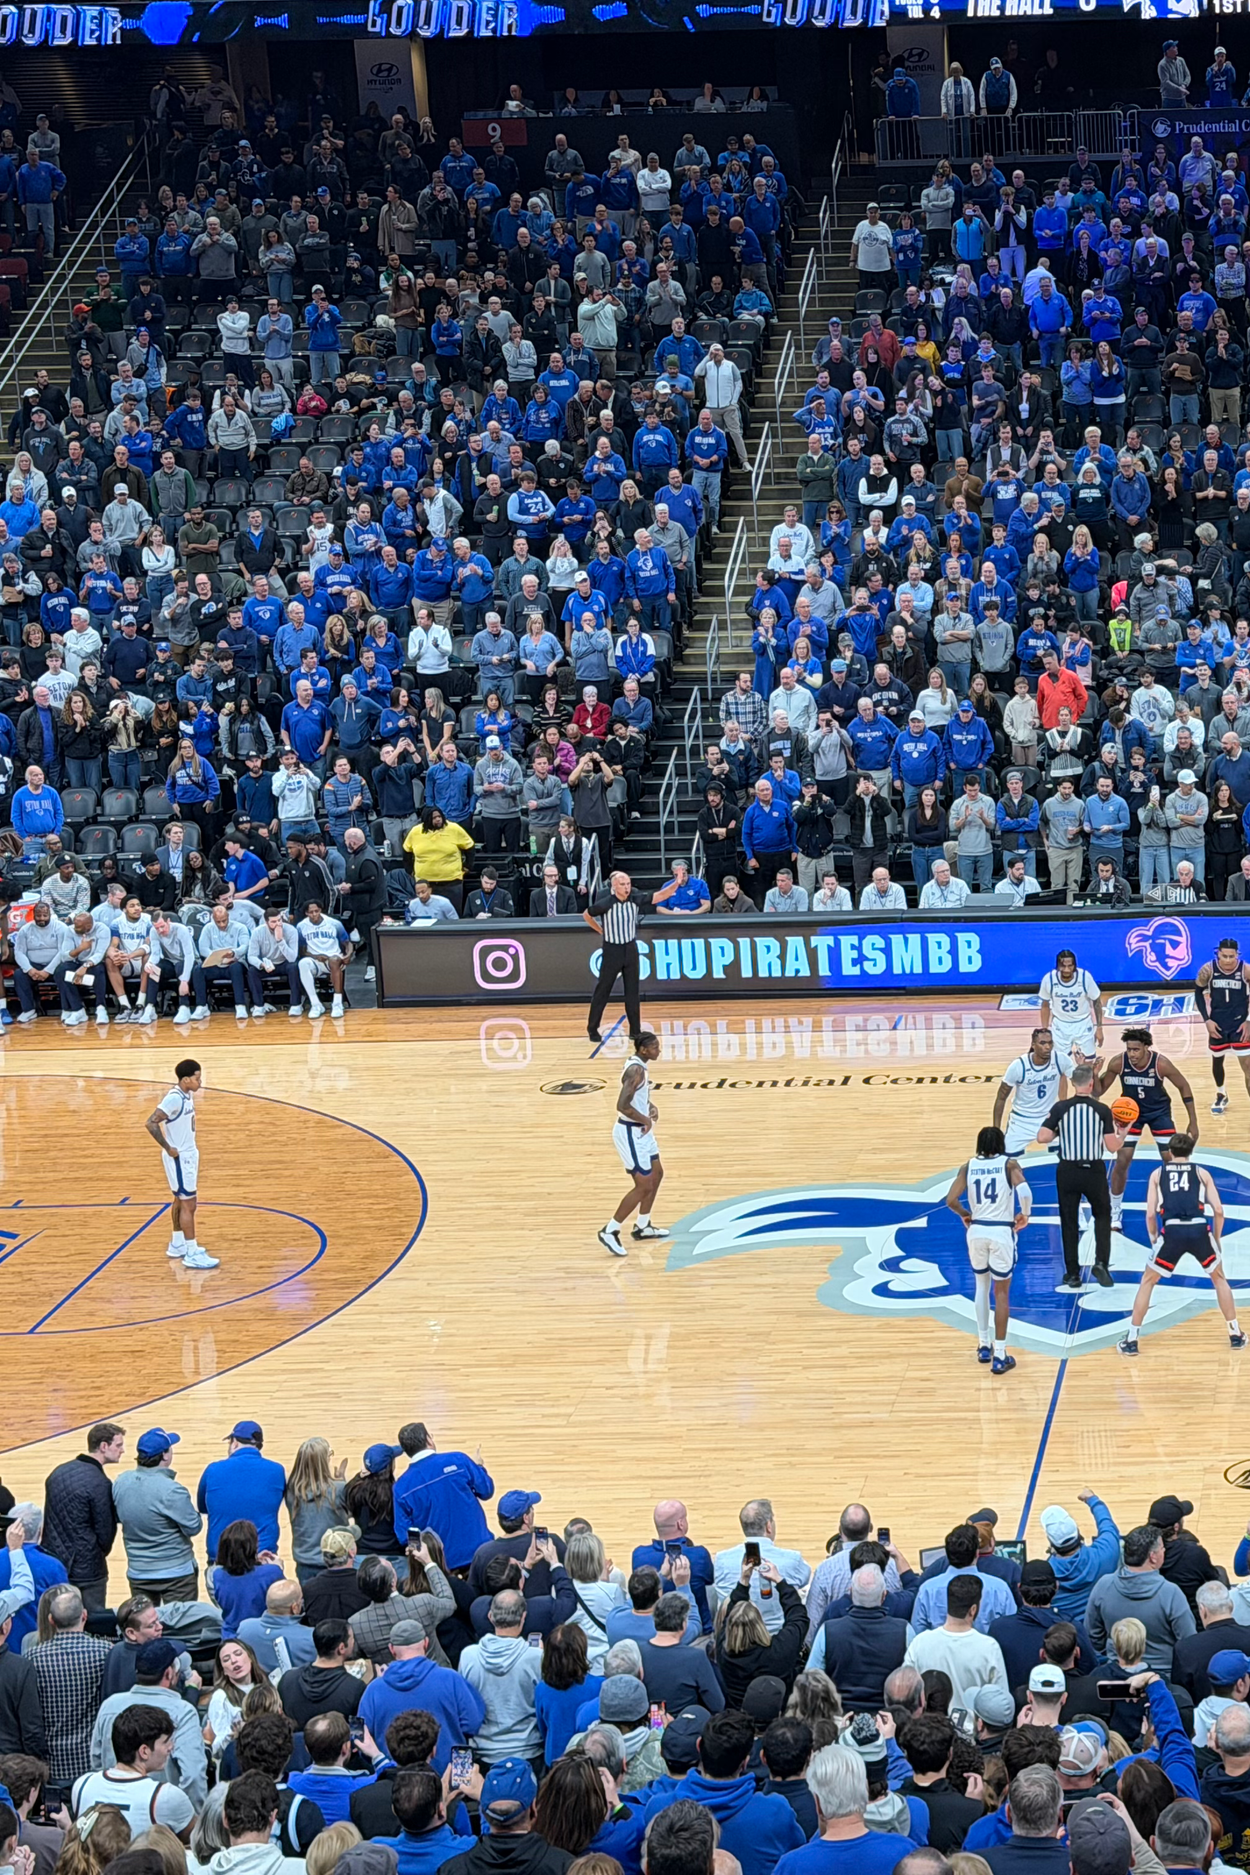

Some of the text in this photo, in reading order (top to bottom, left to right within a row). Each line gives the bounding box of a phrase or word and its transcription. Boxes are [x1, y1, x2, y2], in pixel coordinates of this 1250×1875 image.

[908, 5, 941, 19] TOL 4
[967, 0, 1054, 17] THE HALL
[1213, 0, 1243, 13] 1ST
[1215, 81, 1226, 92] 24
[487, 122, 501, 143] 9
[1175, 119, 1239, 134] Prudential
[528, 503, 544, 512] 24
[317, 541, 328, 552] 15
[48, 681, 73, 694] SETON
[9, 910, 22, 924] G
[1054, 990, 1082, 1000] Seton Hall
[1225, 989, 1230, 1003] 1
[1061, 999, 1079, 1012] 23
[646, 1072, 1003, 1092] rudential Center
[1026, 1073, 1057, 1087] Seton Hall
[1037, 1085, 1047, 1100] 6
[1138, 1087, 1145, 1099] 5
[1165, 1164, 1192, 1172] MULLINS
[1169, 1171, 1190, 1192] 24
[973, 1177, 999, 1205] 14
